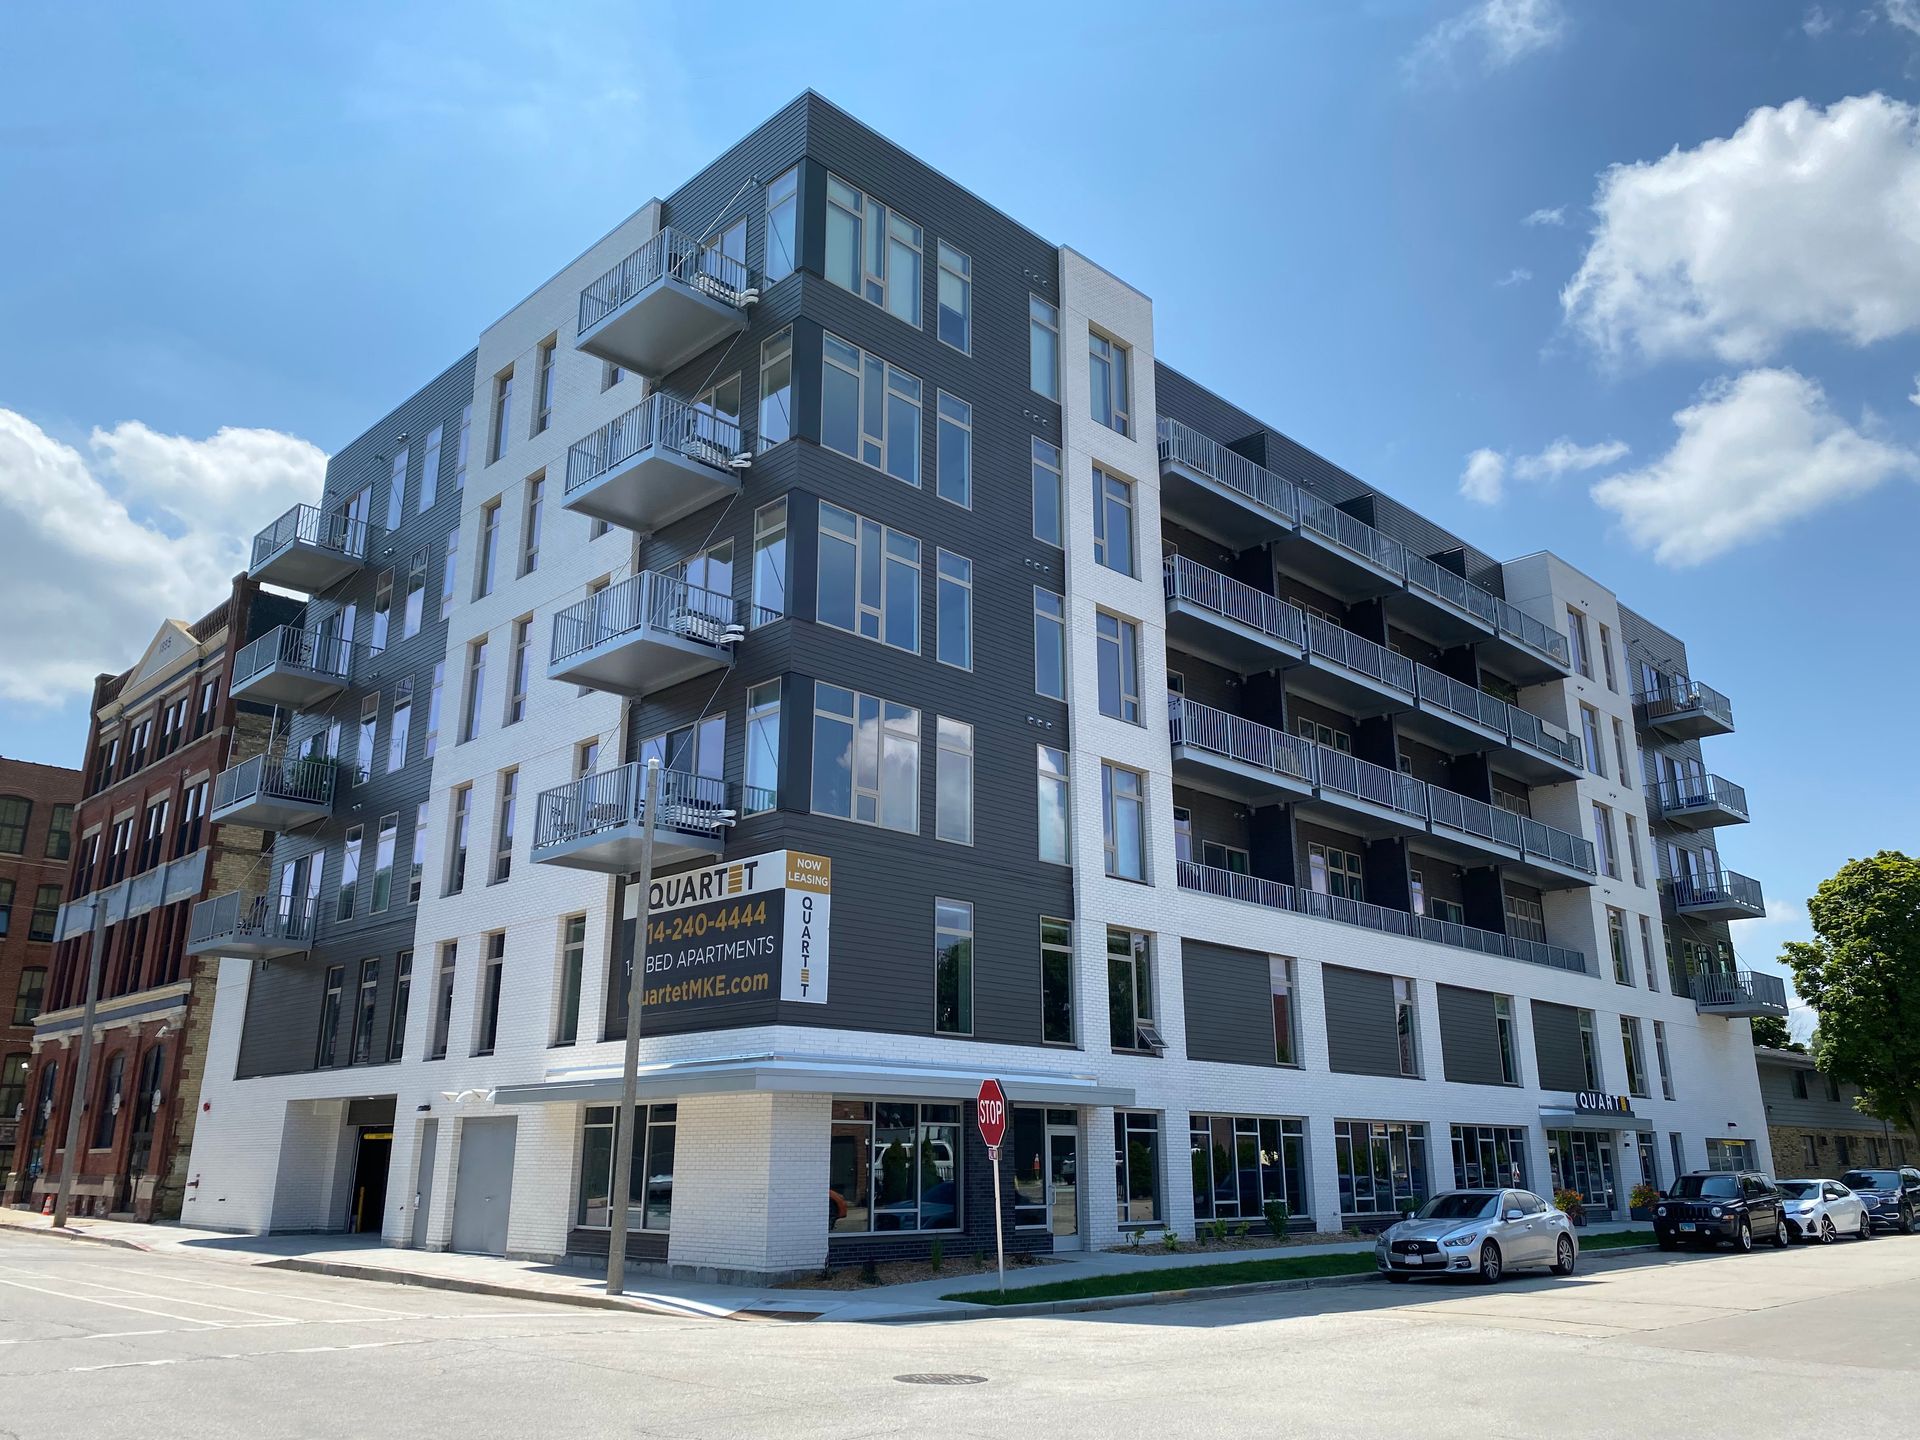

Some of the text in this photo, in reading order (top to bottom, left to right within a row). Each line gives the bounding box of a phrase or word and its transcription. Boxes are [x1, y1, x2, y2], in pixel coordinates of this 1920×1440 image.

[788, 871, 829, 887] LEASING
[797, 858, 822, 871] NOW
[649, 861, 758, 910] QUARTET
[646, 901, 767, 945] 14-240-4444
[645, 953, 673, 974] BED
[676, 935, 774, 969] APARTMENTS
[801, 896, 813, 997] QUARTET
[628, 972, 769, 1008] uartetMKE.com
[979, 1100, 1002, 1125] STOP
